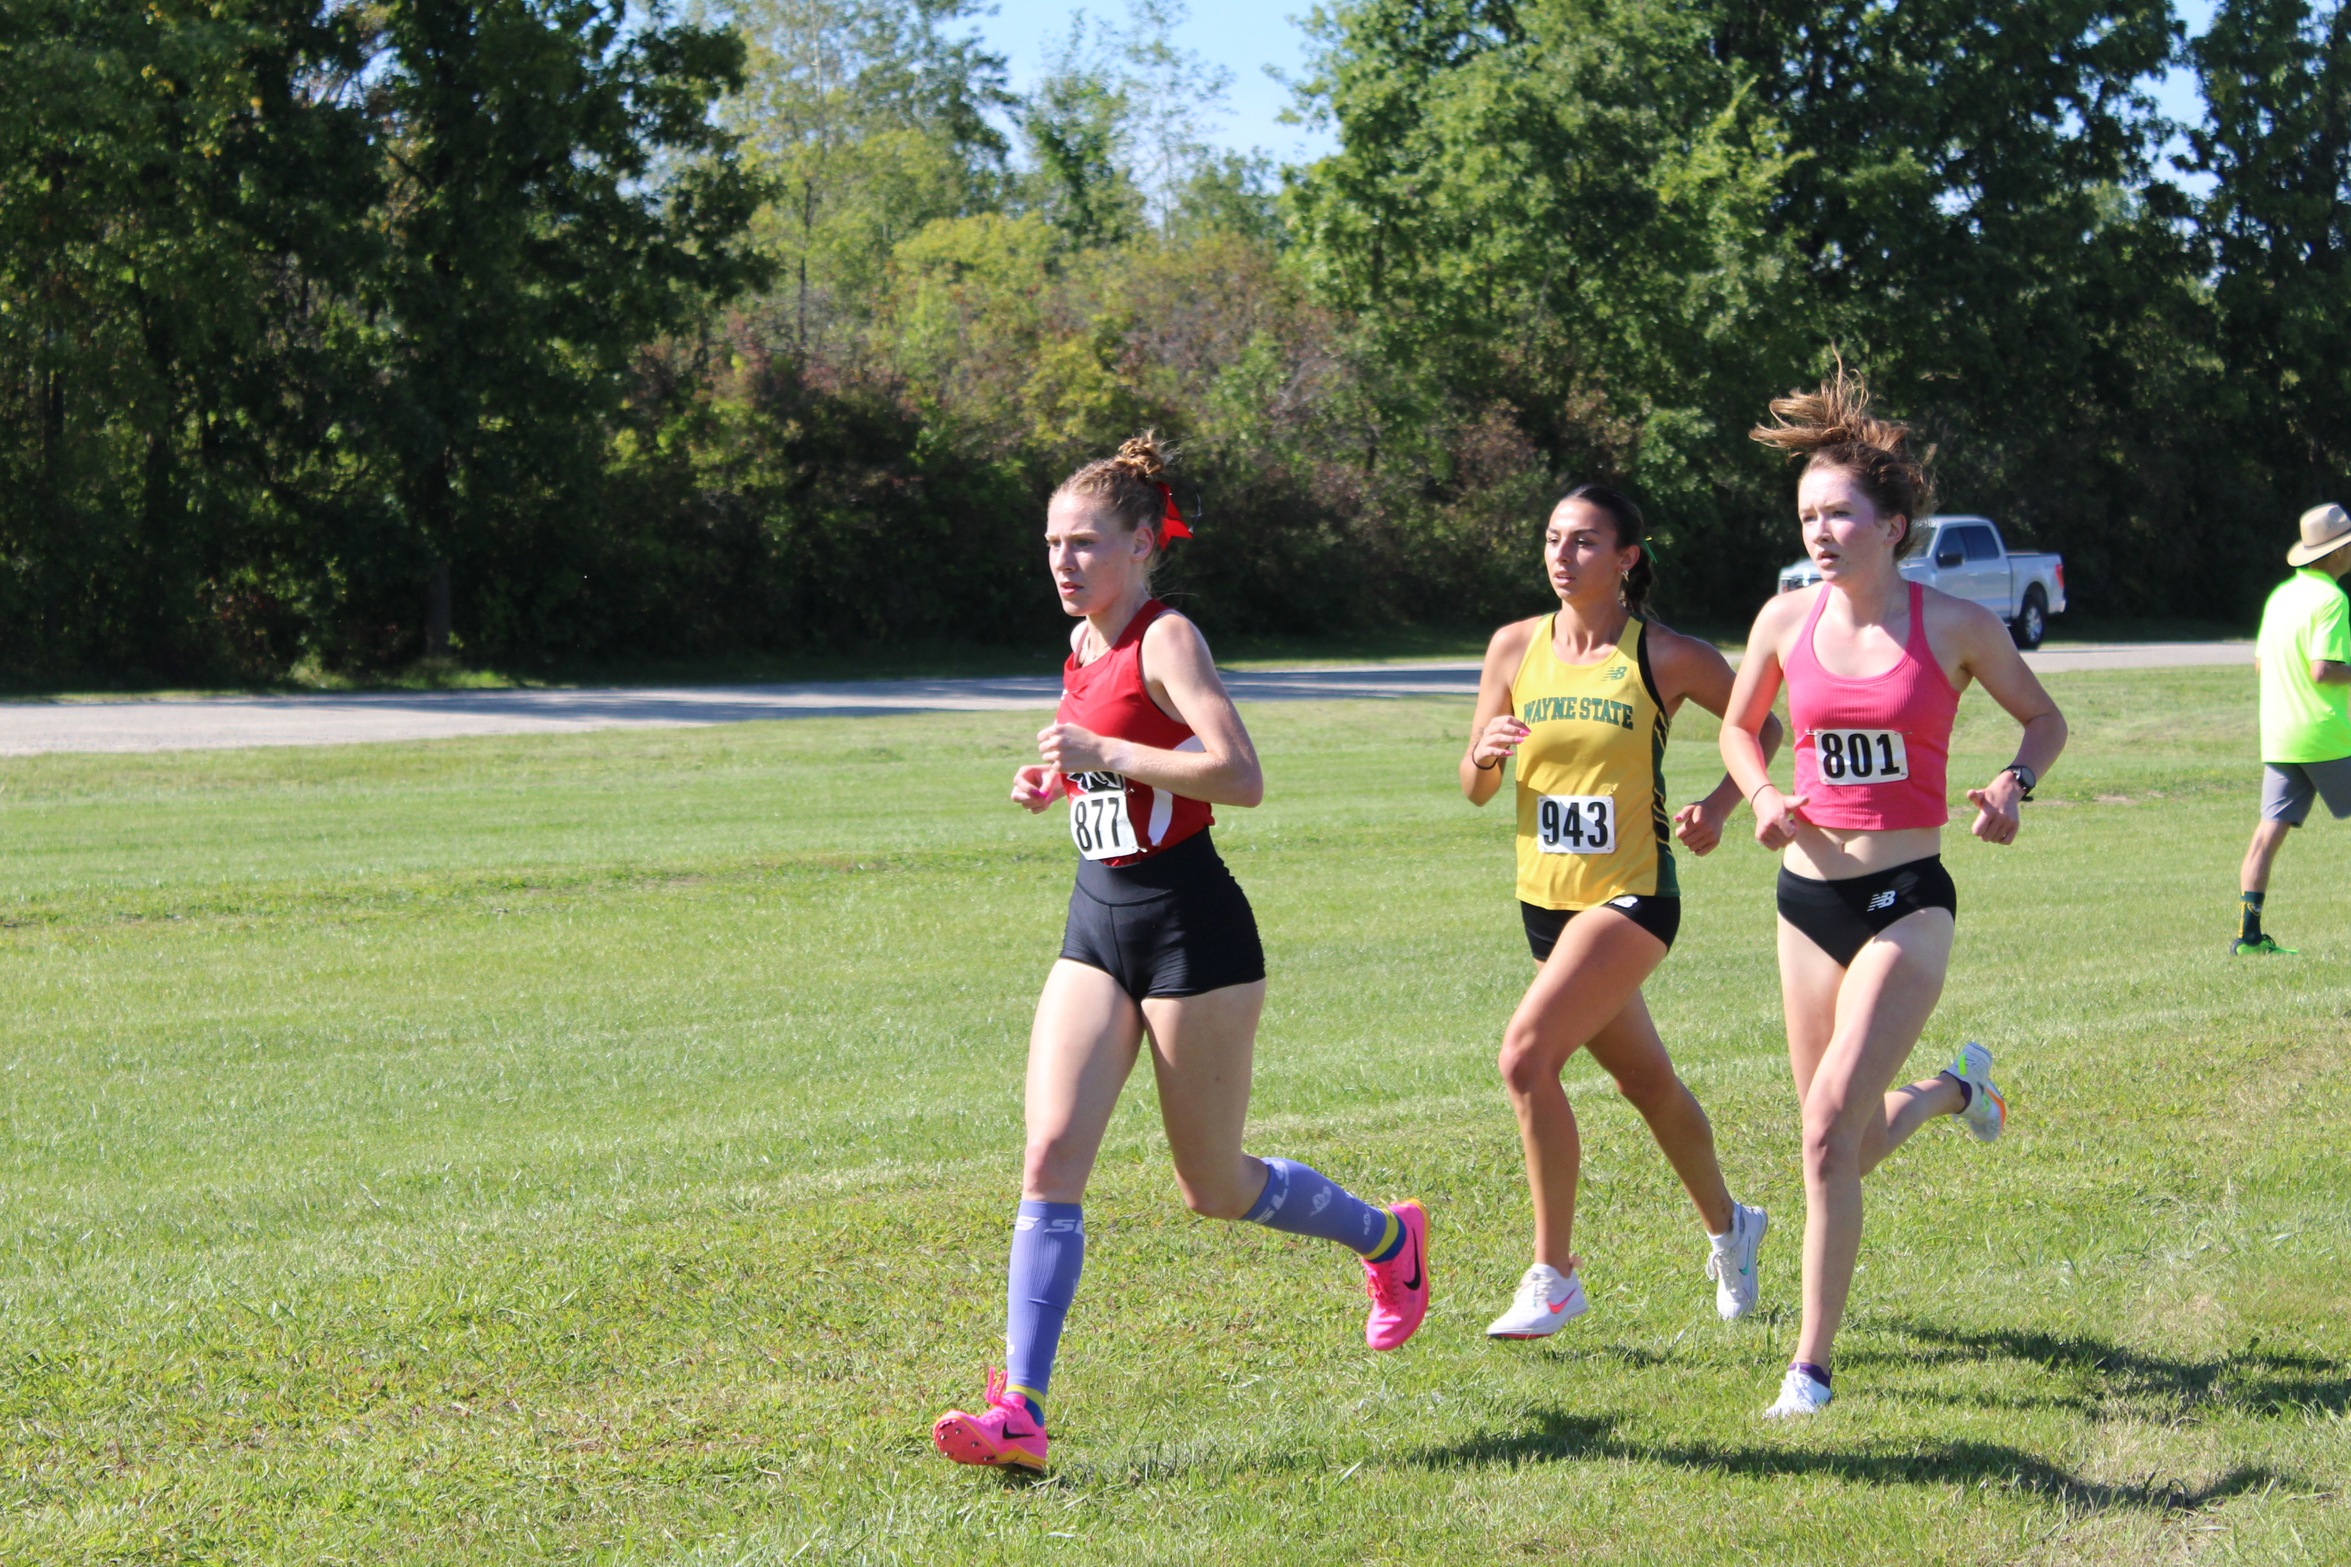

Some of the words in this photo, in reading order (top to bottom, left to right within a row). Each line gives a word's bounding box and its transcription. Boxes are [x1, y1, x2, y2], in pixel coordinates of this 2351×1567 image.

[1524, 697, 1577, 725] WAYNE
[1579, 697, 1633, 730] STATE
[1821, 733, 1899, 778] 801
[1075, 797, 1120, 852] 877
[1542, 801, 1608, 848] 943
